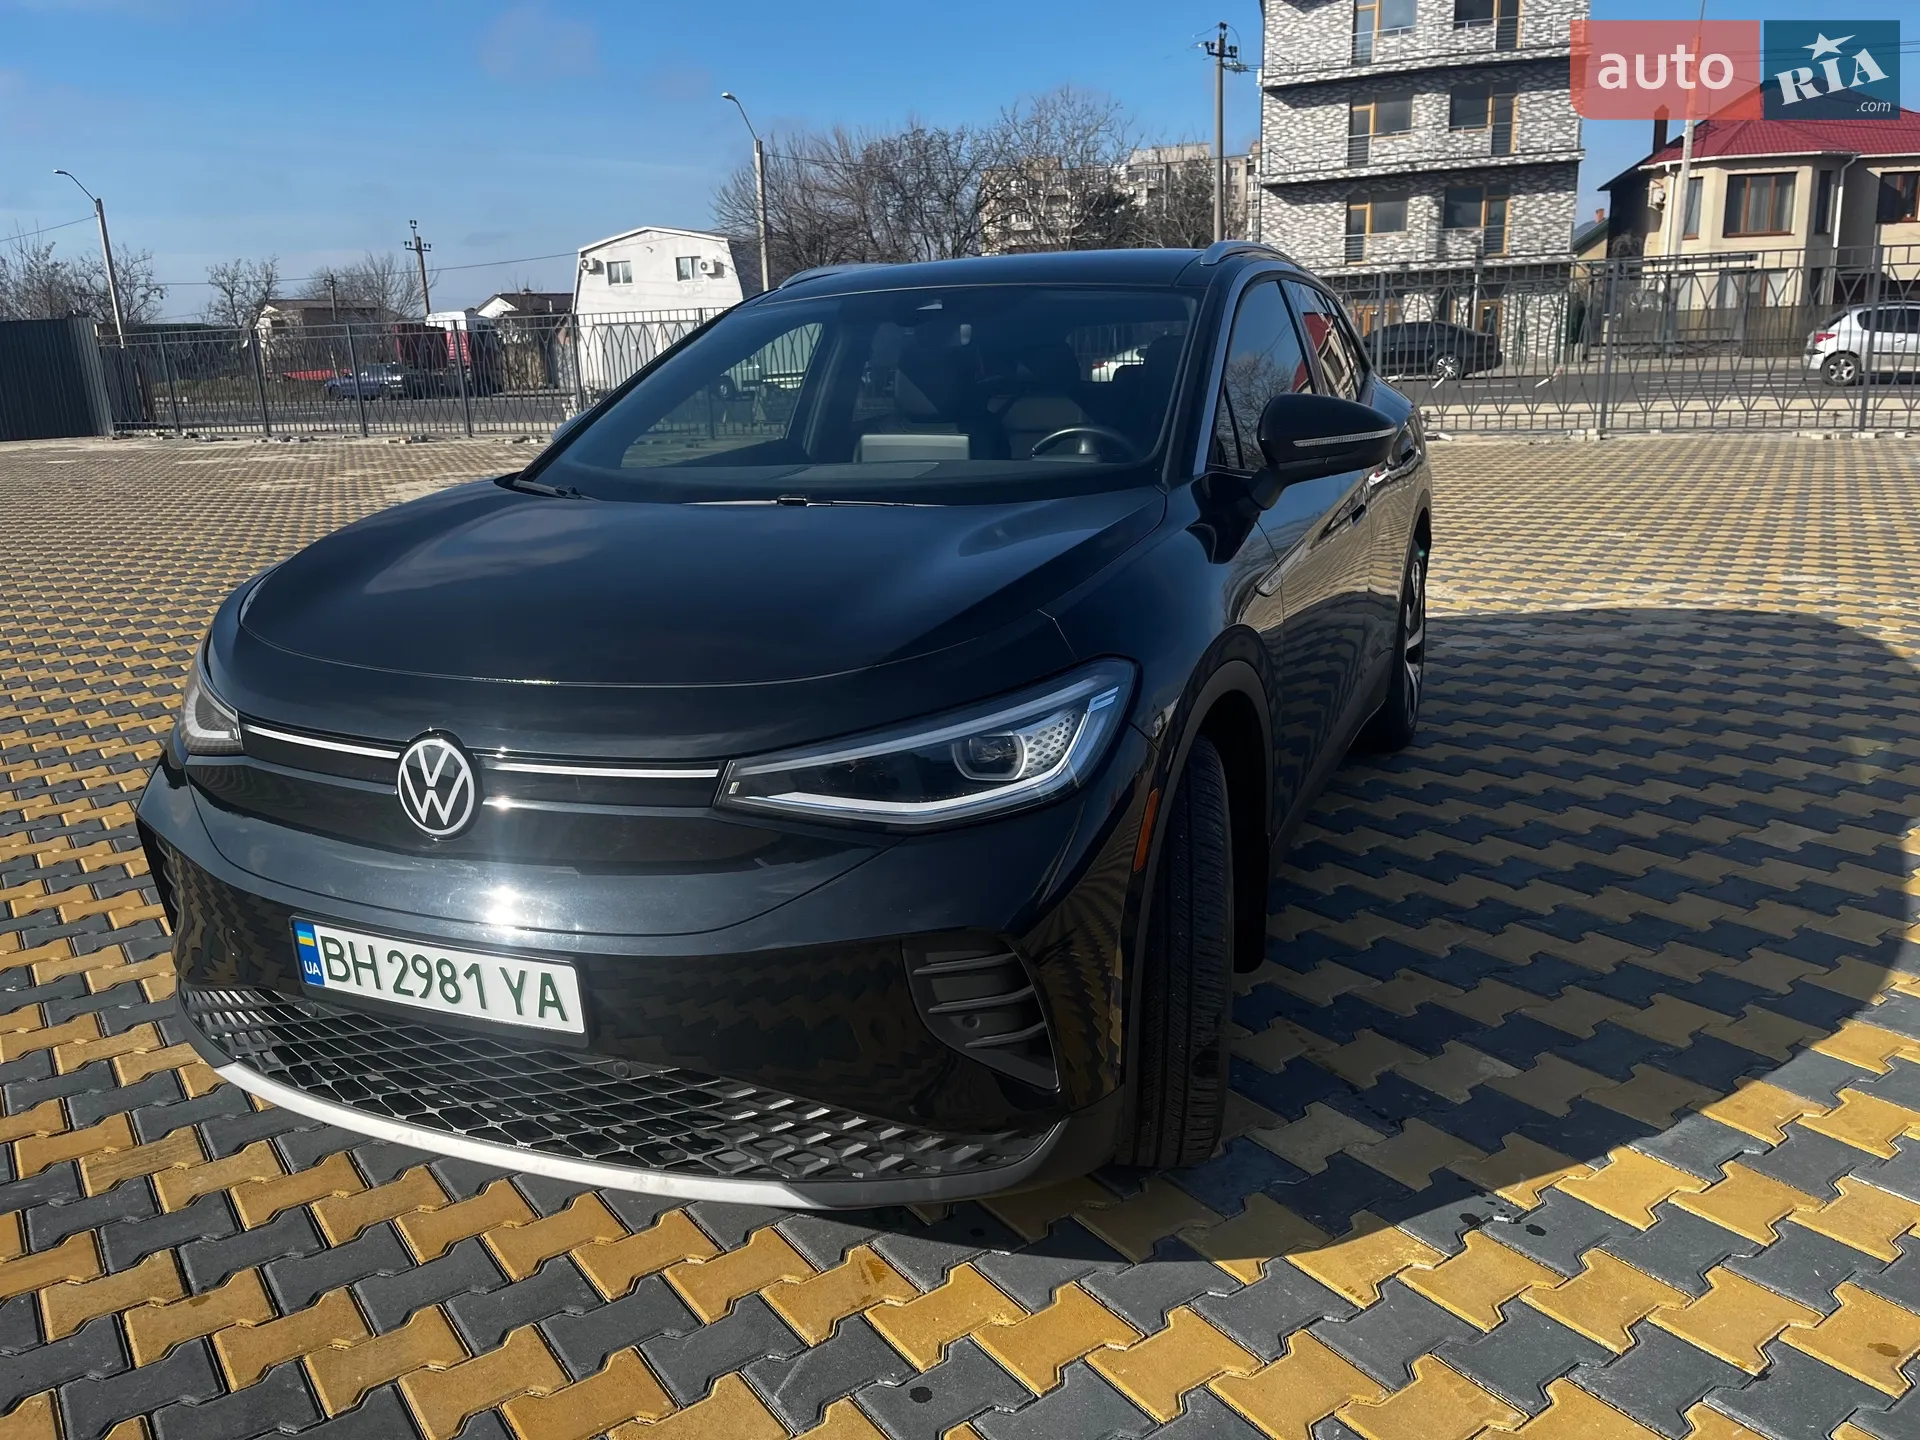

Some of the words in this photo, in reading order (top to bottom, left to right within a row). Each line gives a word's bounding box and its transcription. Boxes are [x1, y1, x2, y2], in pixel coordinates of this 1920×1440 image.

[304, 959, 322, 978] UA
[320, 934, 383, 991] BH
[387, 949, 488, 1011] 2981
[498, 966, 570, 1022] YA
